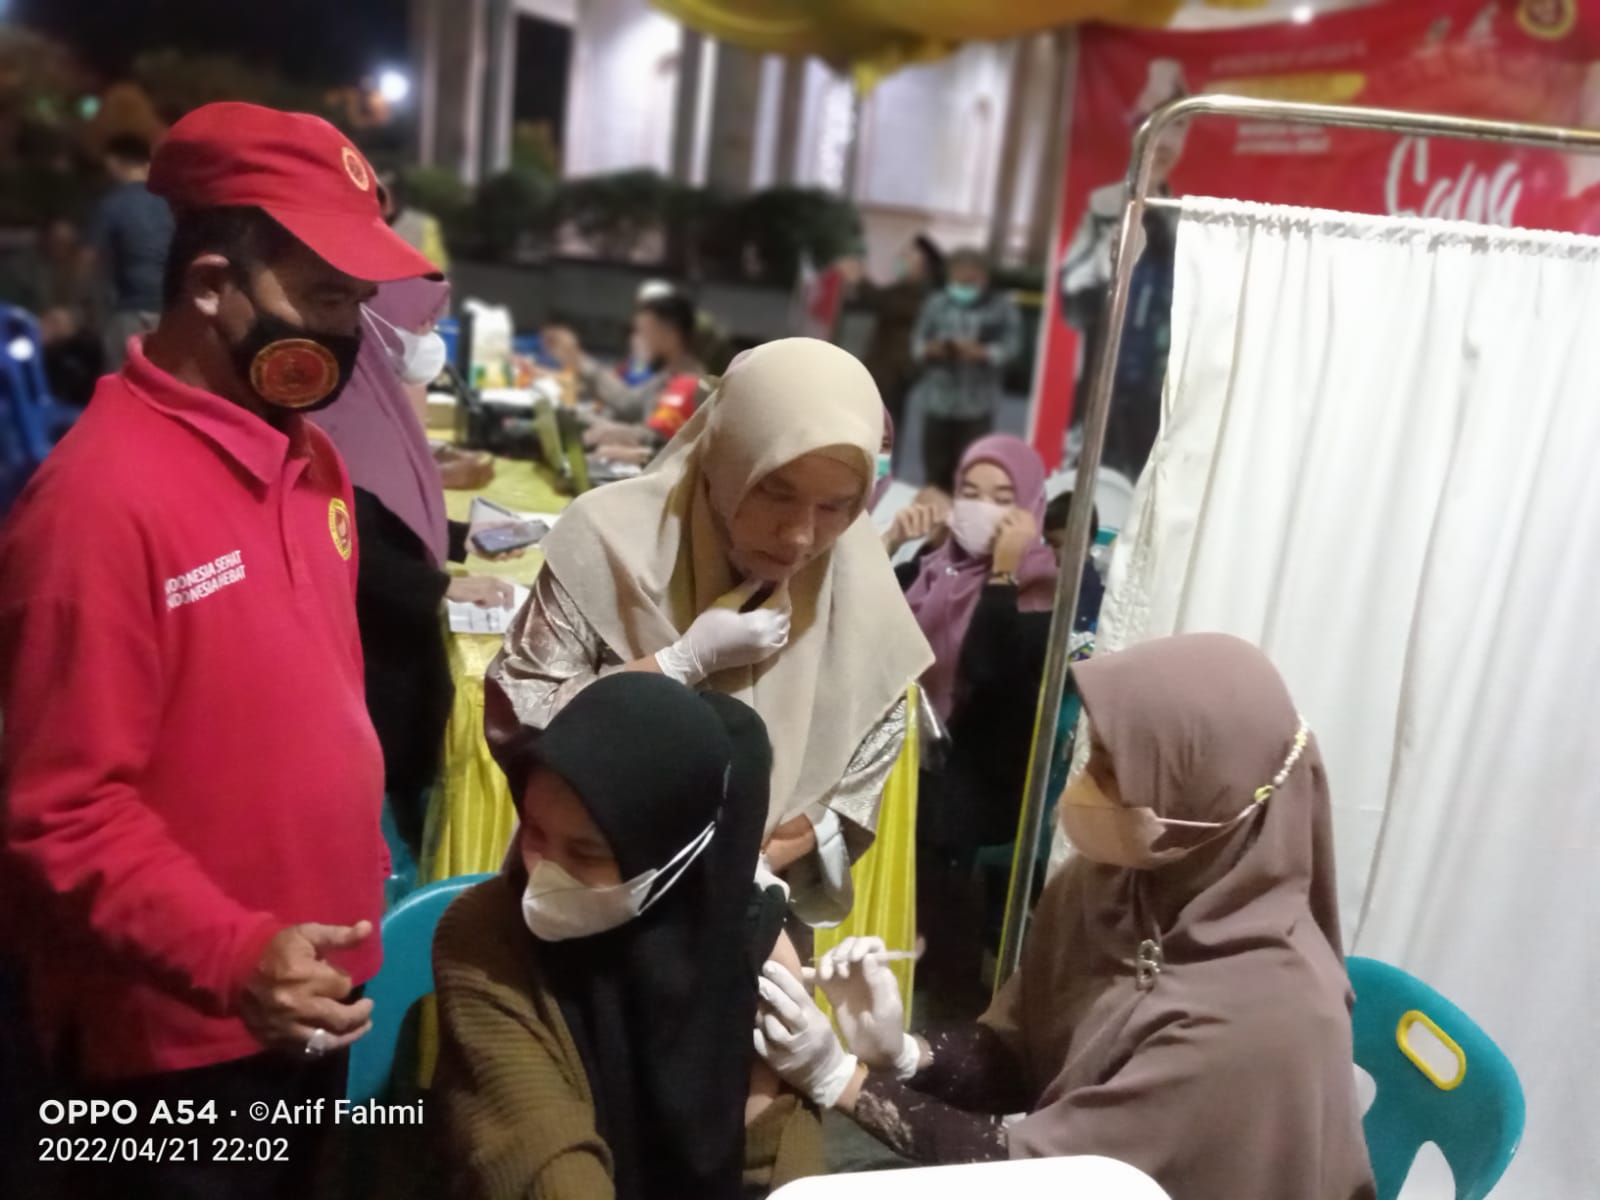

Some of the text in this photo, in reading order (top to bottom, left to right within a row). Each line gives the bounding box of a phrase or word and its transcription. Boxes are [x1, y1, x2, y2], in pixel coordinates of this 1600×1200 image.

[164, 549, 242, 595] NDONESIA SEHAT
[166, 577, 220, 611] NDONESIA
